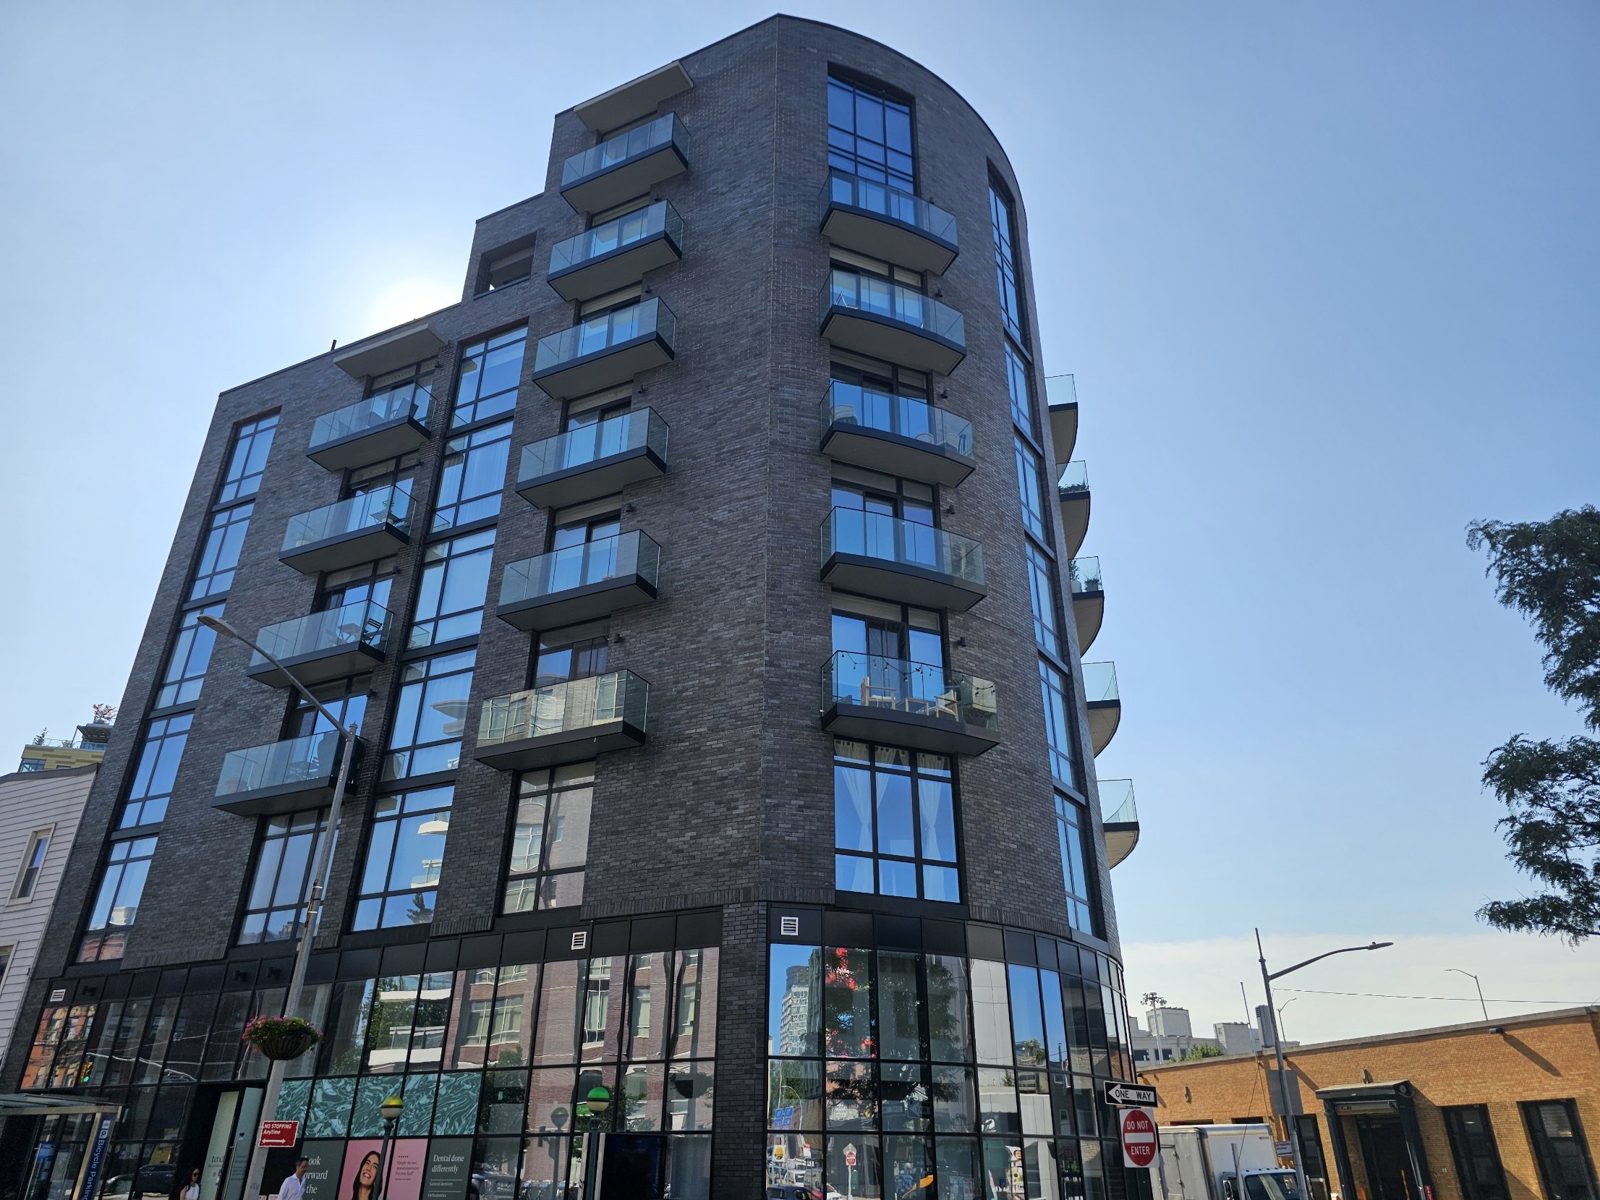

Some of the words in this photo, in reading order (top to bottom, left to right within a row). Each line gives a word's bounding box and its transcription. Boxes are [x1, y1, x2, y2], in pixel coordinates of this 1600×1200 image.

[1115, 1089, 1129, 1098] ONE
[1136, 1091, 1152, 1100] WAY
[1126, 1120, 1136, 1130] DO
[1136, 1120, 1149, 1130] NOT
[92, 1139, 104, 1168] Bicycle
[1130, 1145, 1150, 1156] ENTER
[433, 1154, 452, 1162] Dental
[451, 1154, 464, 1162] done
[432, 1164, 459, 1174] differently
[304, 1170, 328, 1180] orward
[306, 1184, 318, 1194] the
